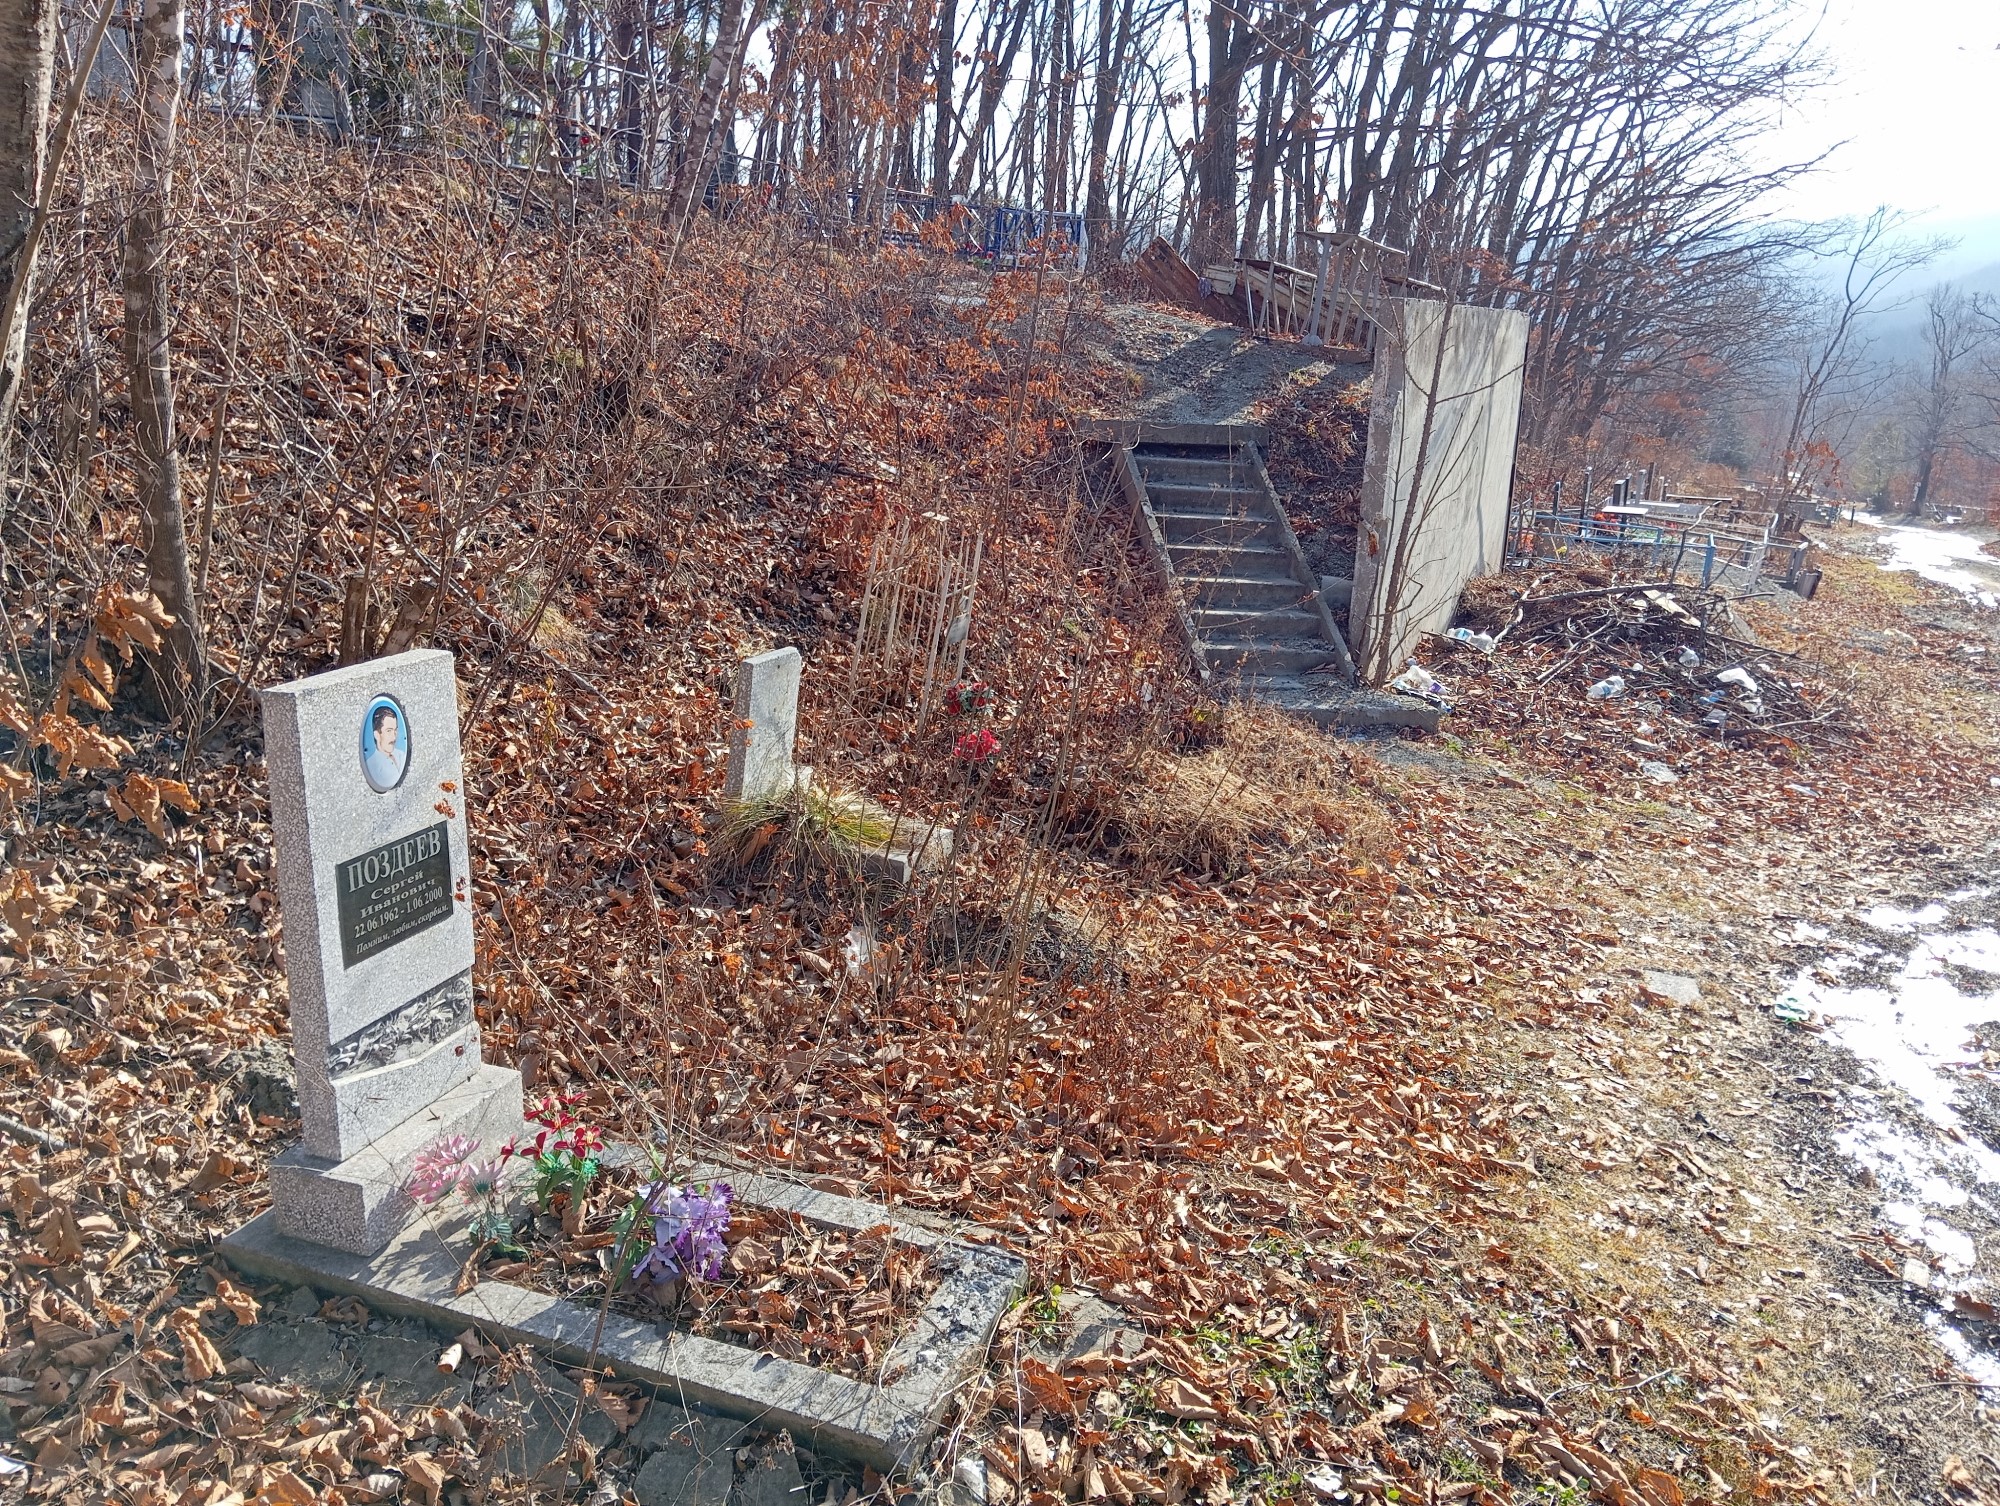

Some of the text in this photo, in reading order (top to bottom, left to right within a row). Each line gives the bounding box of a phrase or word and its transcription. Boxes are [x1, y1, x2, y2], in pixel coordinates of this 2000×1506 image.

[347, 829, 441, 892] ПОЗДЕЕВ
[360, 878, 436, 919] Иванович
[371, 870, 424, 900] Сергей
[354, 907, 399, 938] 22.06.1962
[406, 886, 443, 913] 1.06.2000
